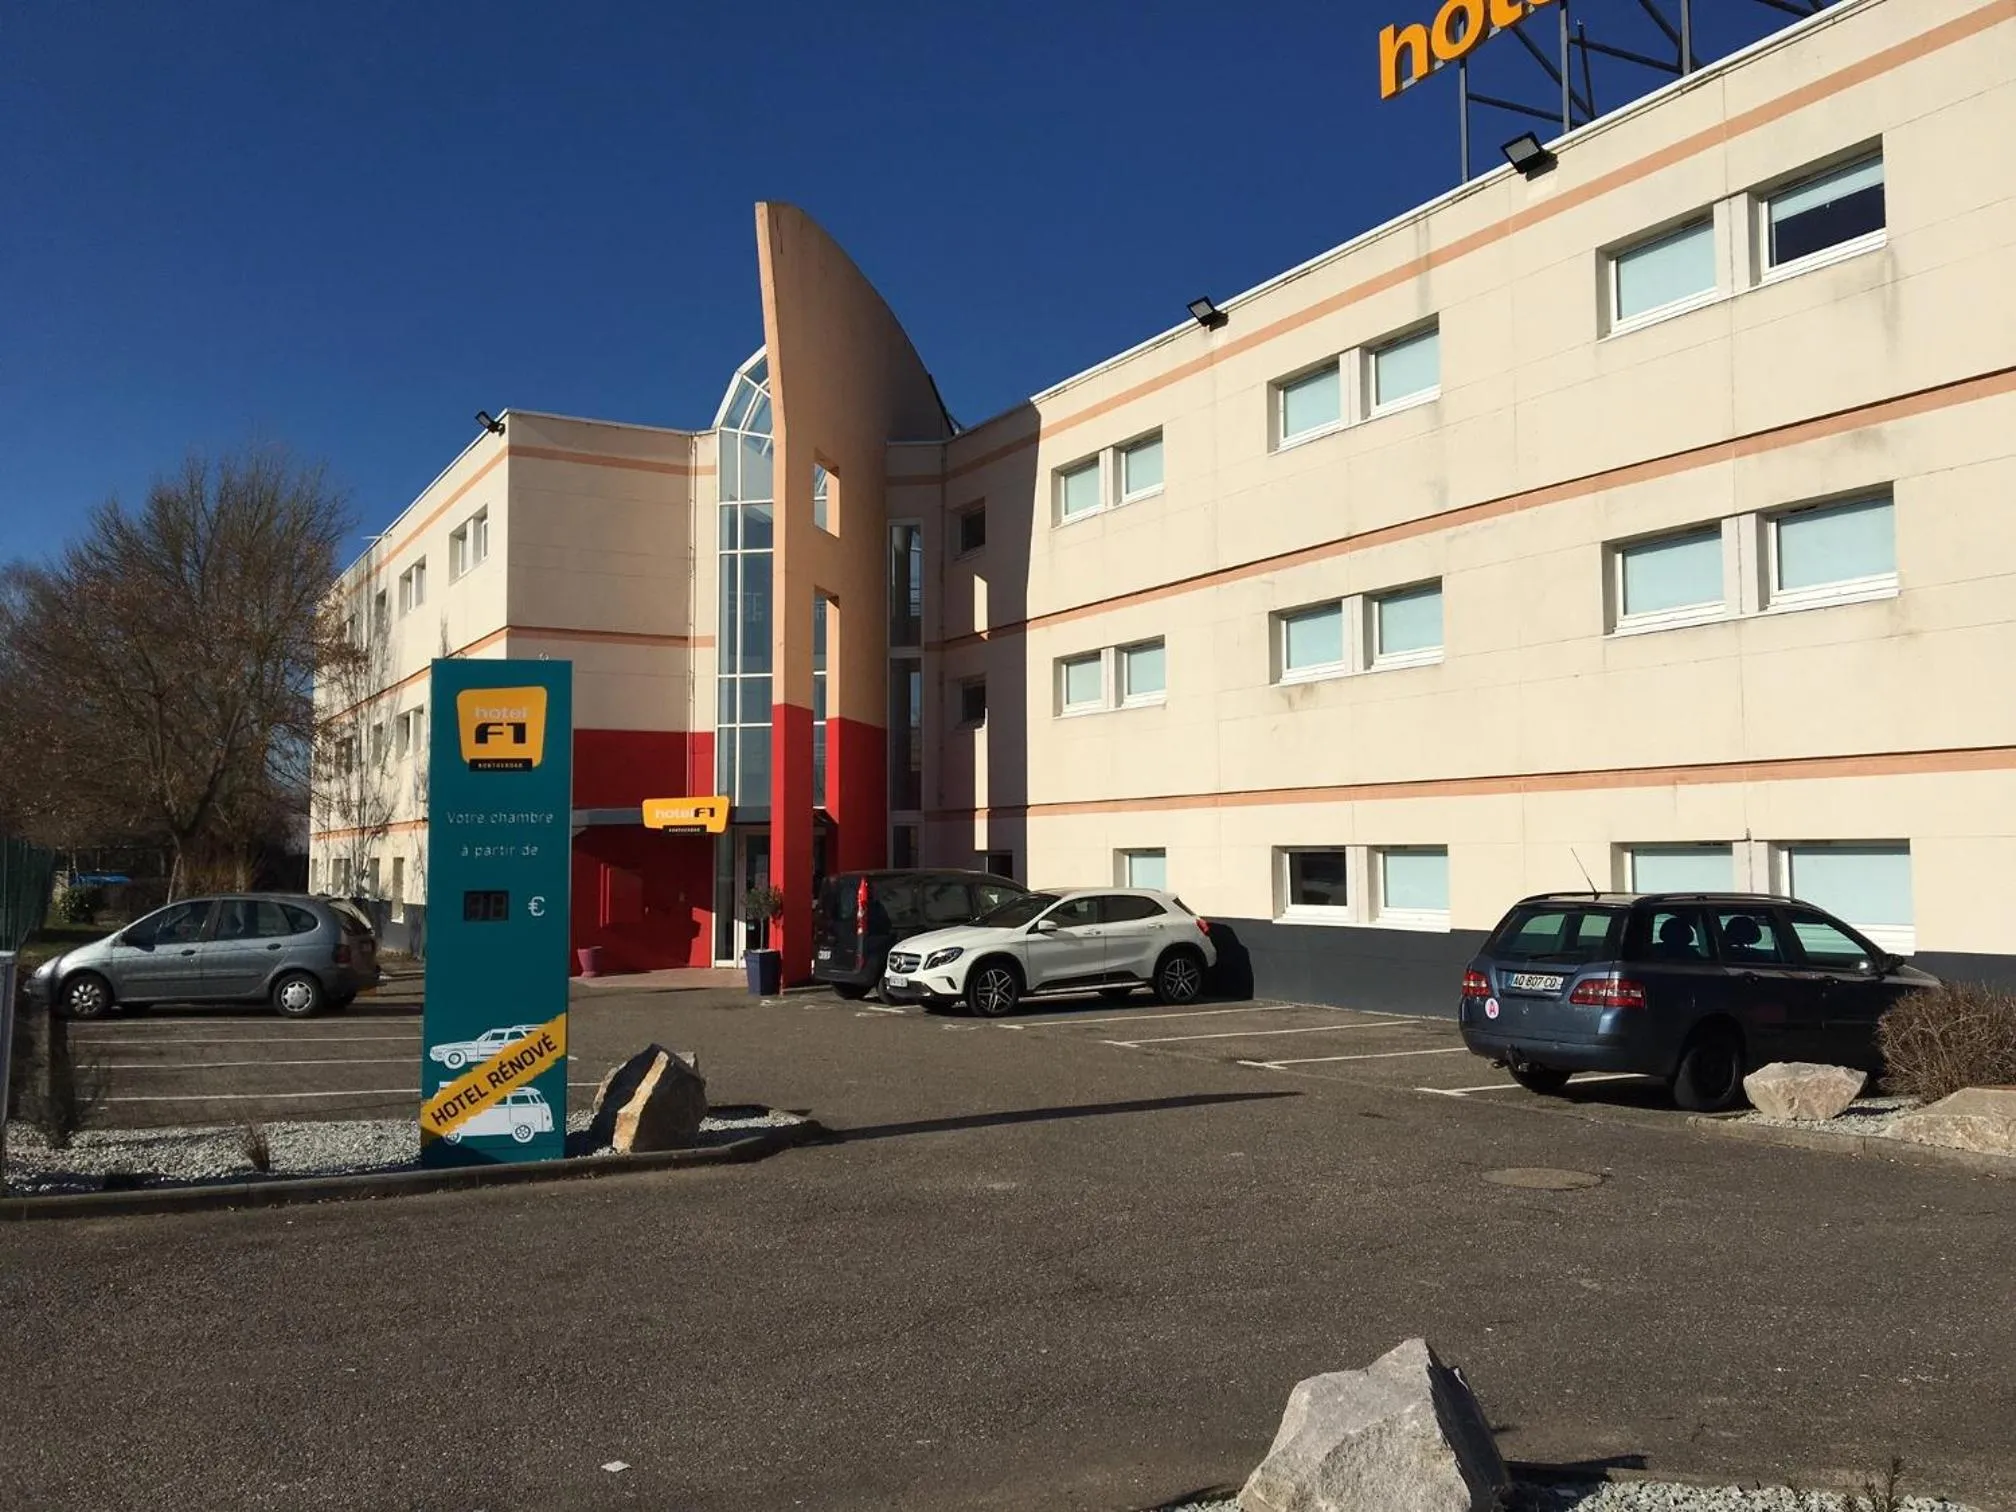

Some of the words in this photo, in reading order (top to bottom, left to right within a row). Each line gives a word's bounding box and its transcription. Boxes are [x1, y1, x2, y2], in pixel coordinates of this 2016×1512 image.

[475, 707, 527, 719] hotel
[475, 722, 526, 744] F1
[447, 811, 485, 824] Votre
[490, 811, 554, 824] chambre
[474, 845, 516, 860] partir
[521, 844, 539, 856] de
[431, 1082, 489, 1127] HOTEL
[487, 1033, 558, 1089] RÉNOVÉ
